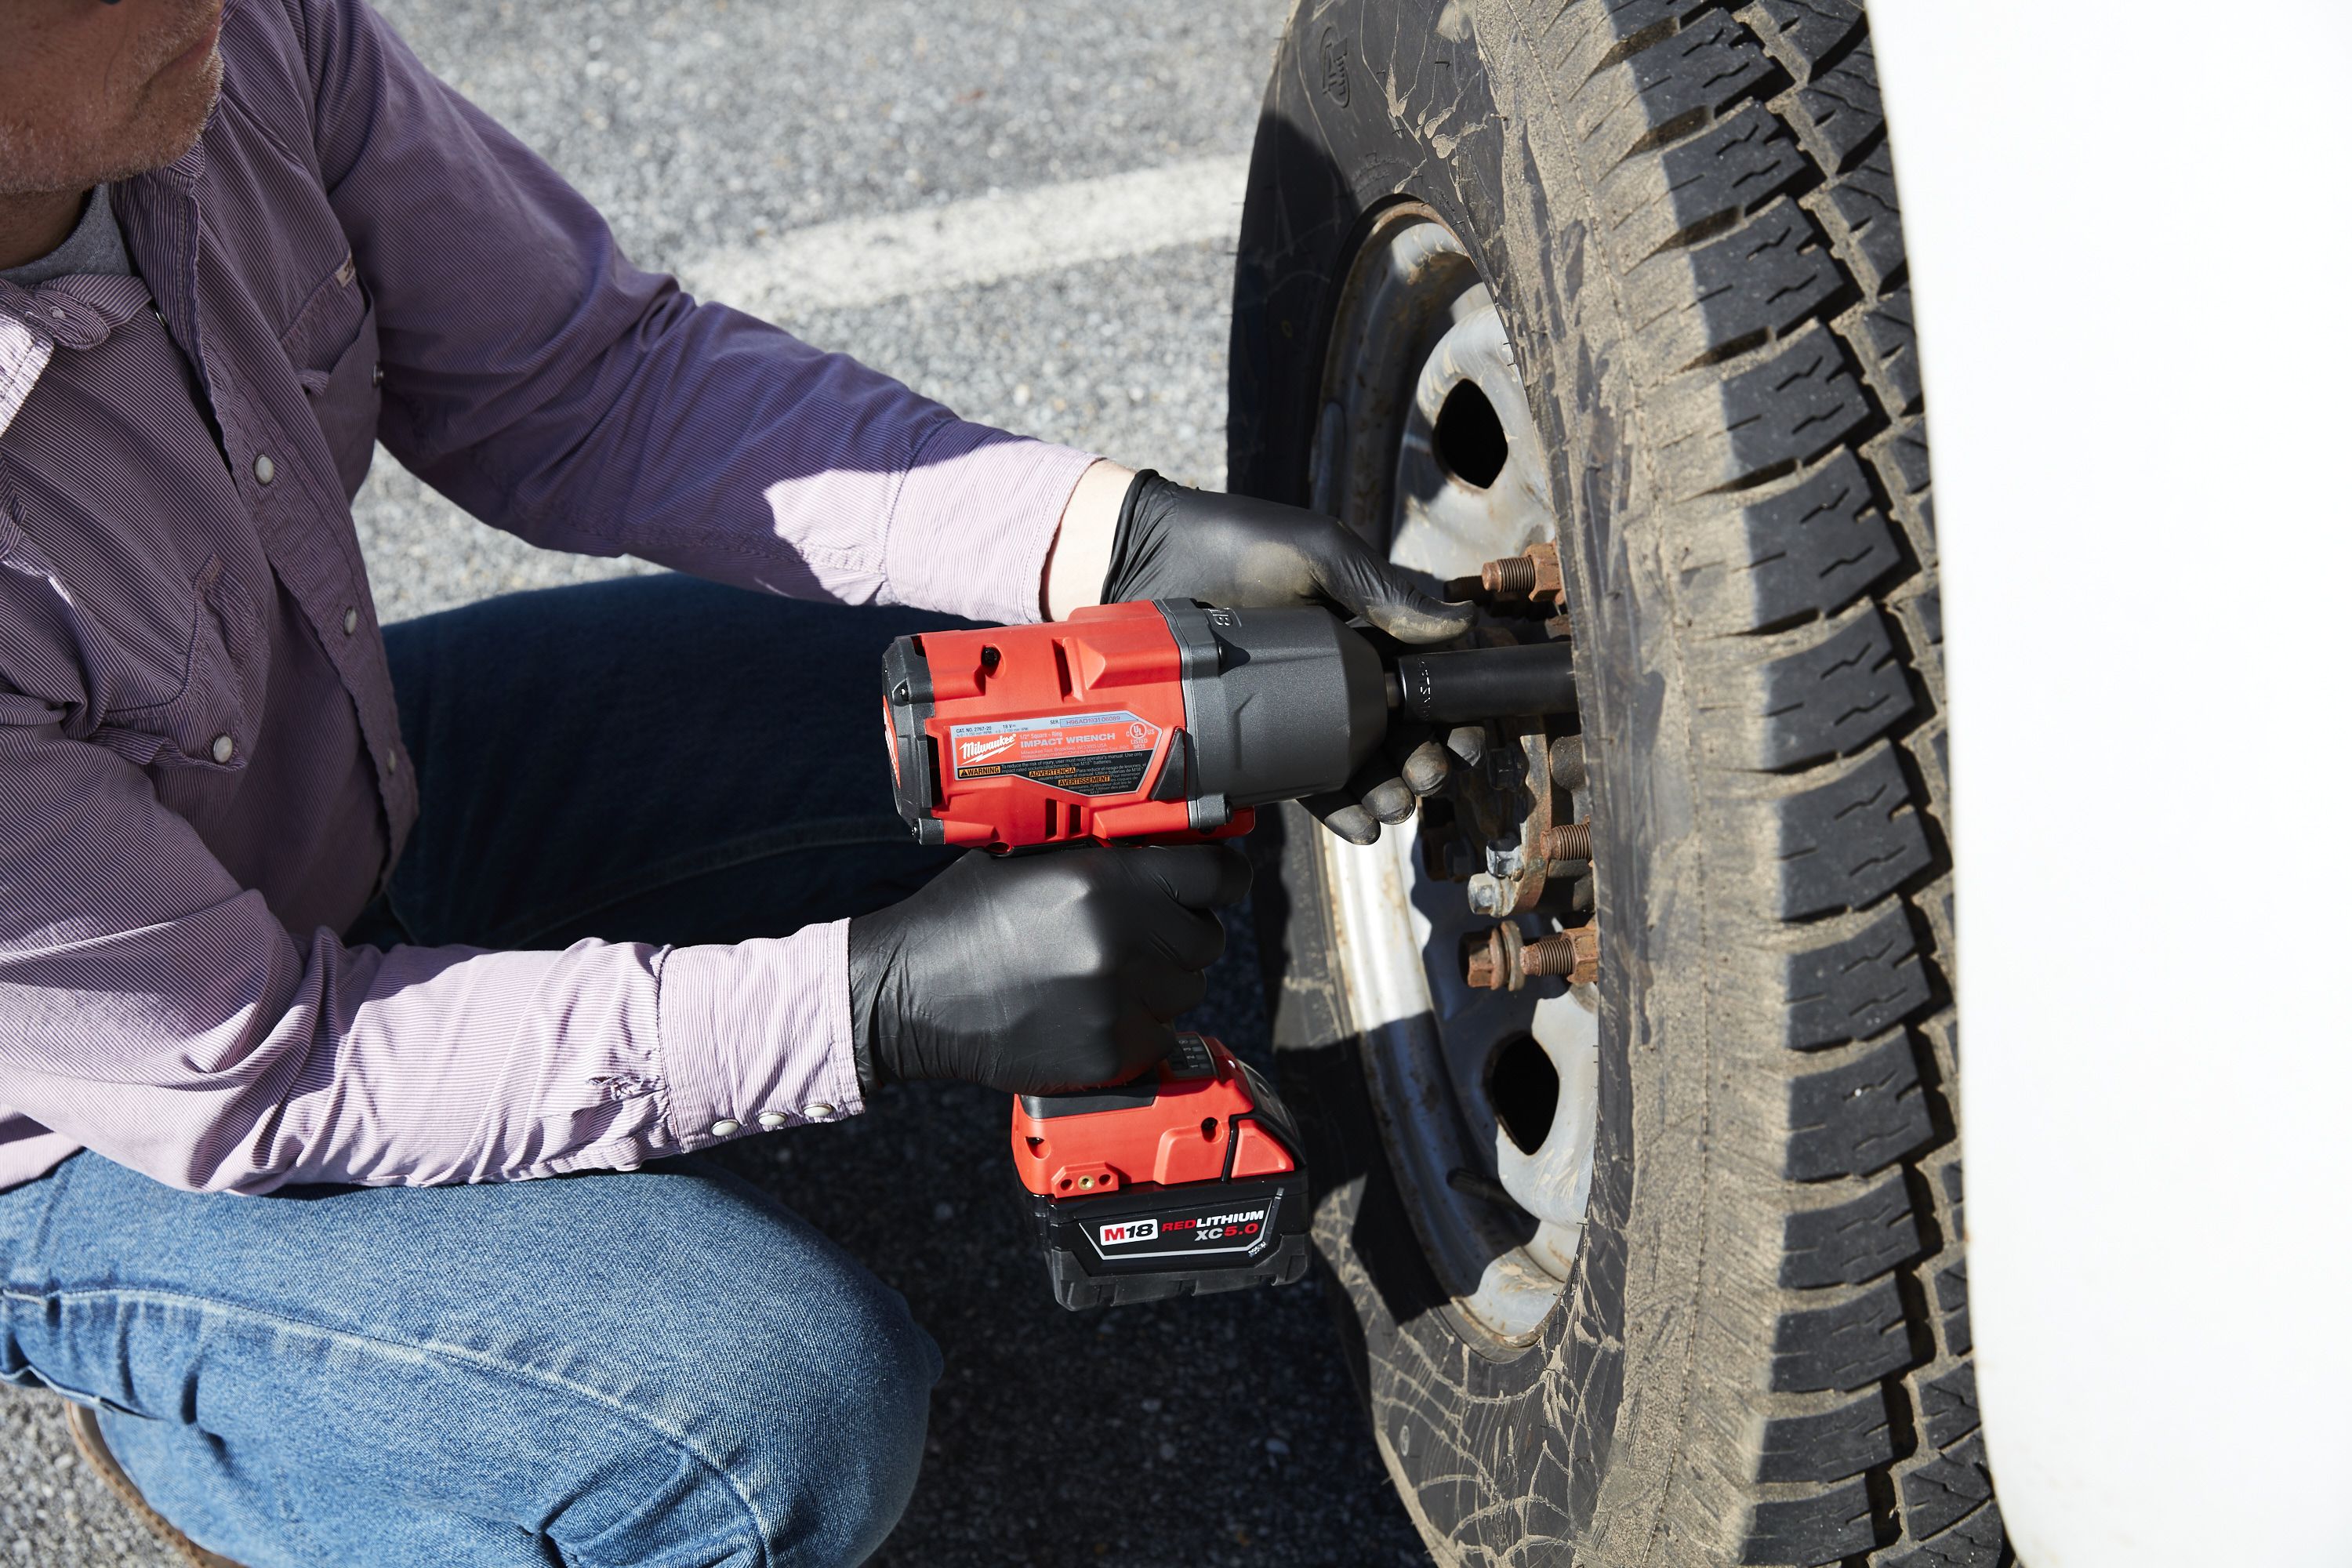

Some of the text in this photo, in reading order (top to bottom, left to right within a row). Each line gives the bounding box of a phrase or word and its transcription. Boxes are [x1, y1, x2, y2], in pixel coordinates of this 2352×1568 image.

[959, 735, 1014, 759] Milwaukee
[1021, 733, 1115, 747] IMPACT WRENCH
[1059, 776, 1108, 785] AVERTISSEMENT
[1104, 1210, 1264, 1241] M18 REDLITHIUM
